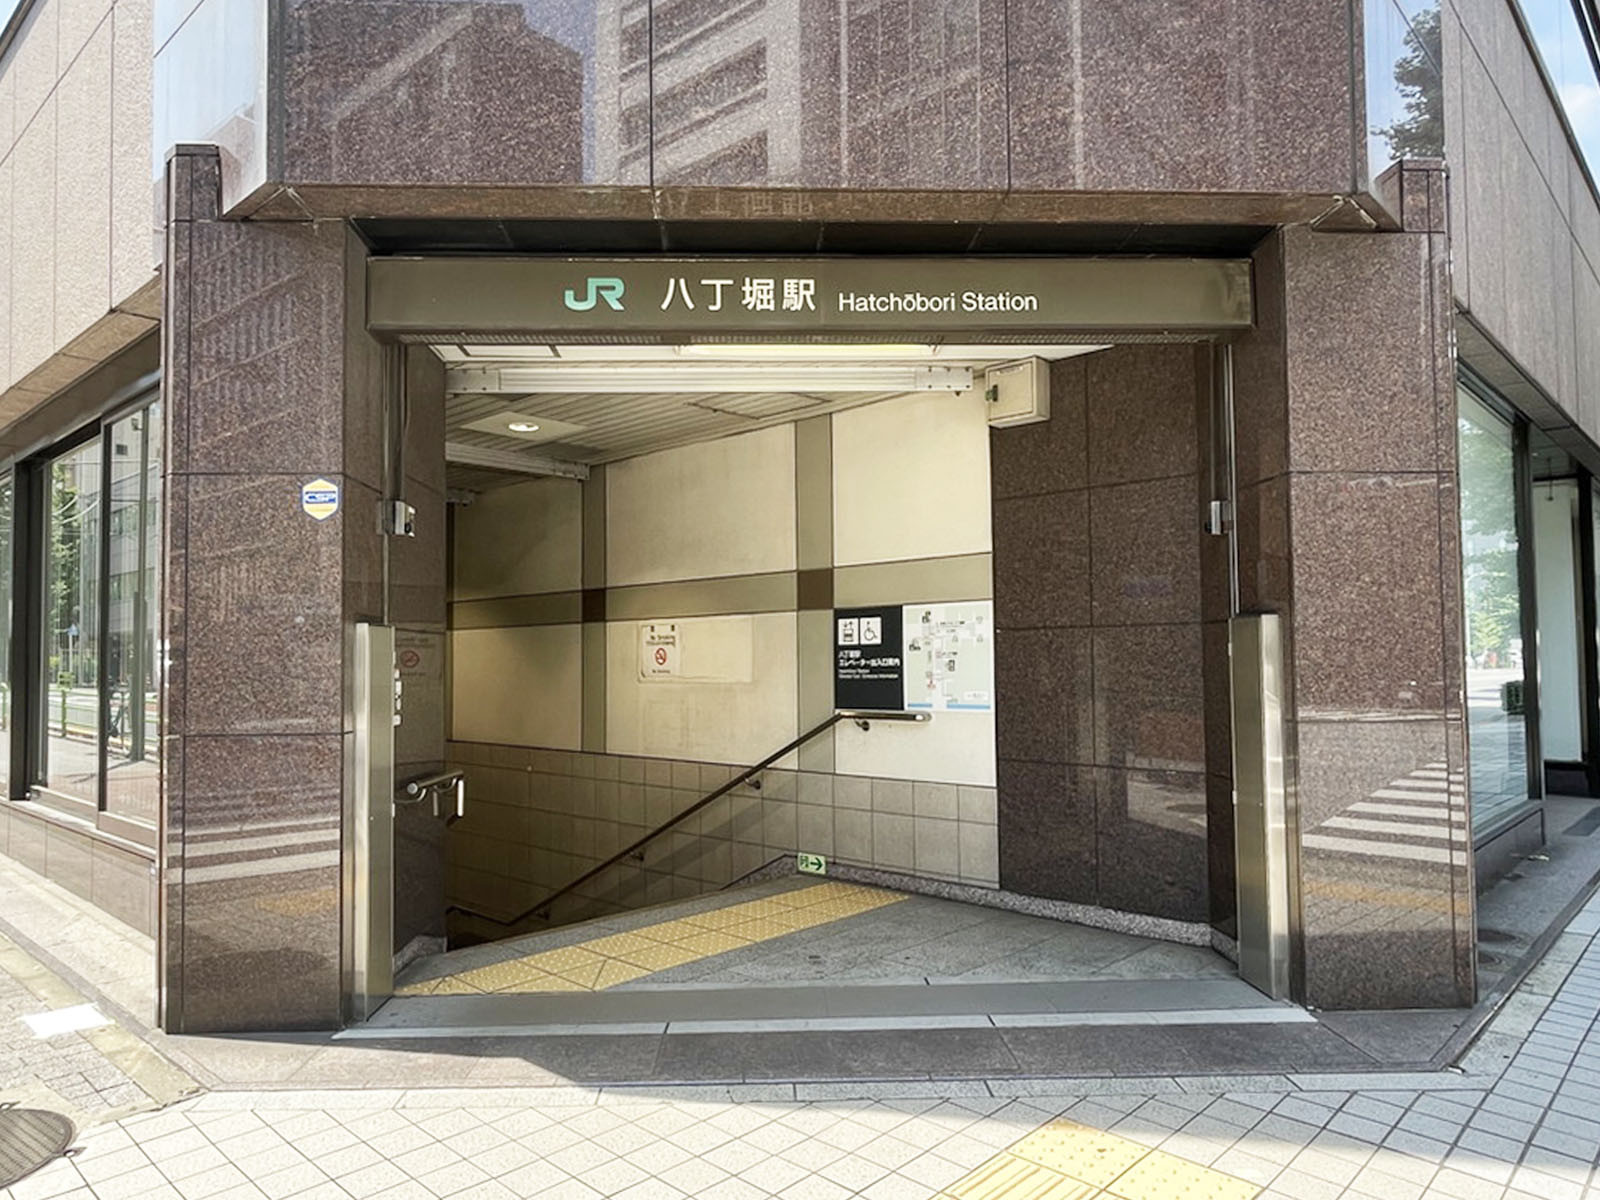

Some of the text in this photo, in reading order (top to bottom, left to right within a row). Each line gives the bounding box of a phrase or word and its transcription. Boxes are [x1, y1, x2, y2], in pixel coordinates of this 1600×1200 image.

[564, 277, 625, 311] JR
[661, 277, 817, 312] 八丁堀駅
[838, 292, 1038, 312] Hatchōbori Station
